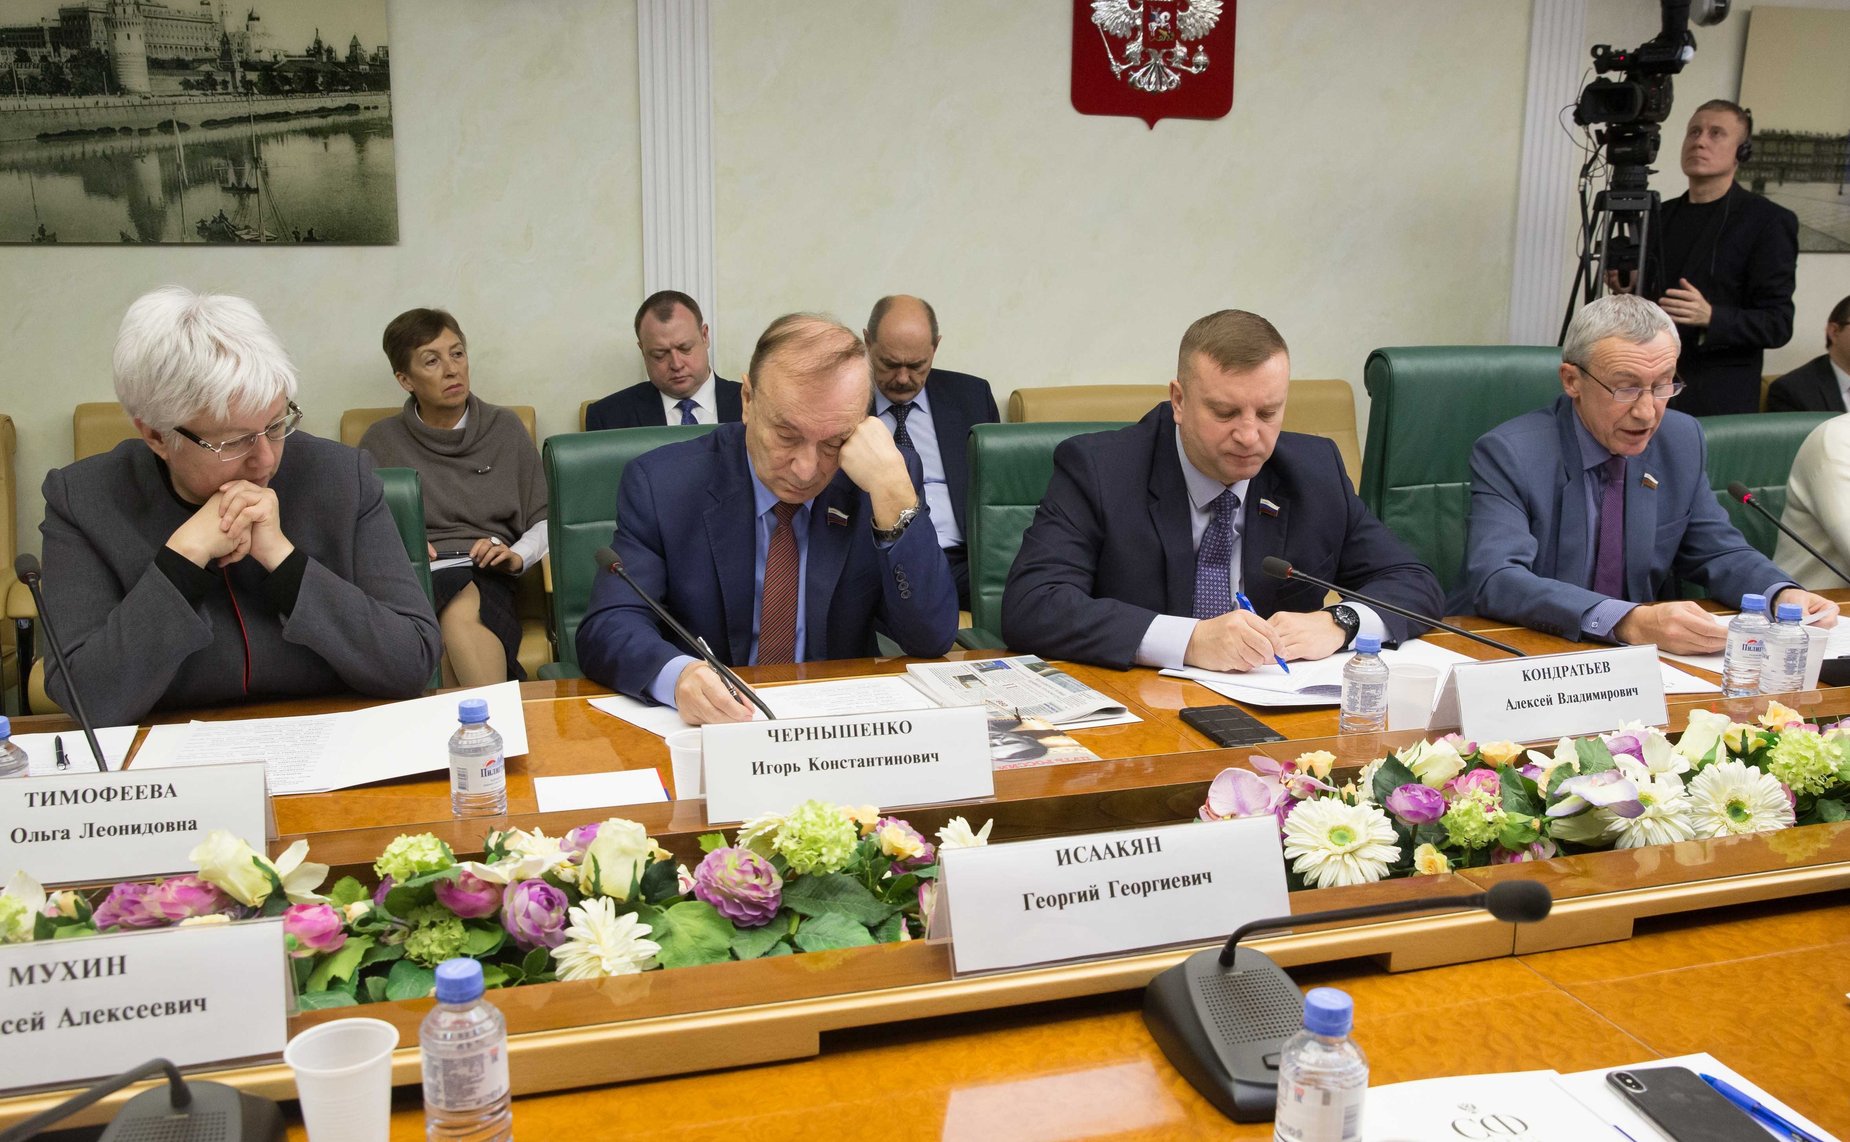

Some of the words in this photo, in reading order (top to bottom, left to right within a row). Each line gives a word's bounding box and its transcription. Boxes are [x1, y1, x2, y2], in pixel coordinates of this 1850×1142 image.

[1522, 660, 1611, 682] КОНДРАТЬЕВ
[1505, 692, 1553, 711] Алексей
[1558, 687, 1639, 705] Владимирович
[767, 720, 913, 743] ЧЕРНЫШЕНКО
[751, 760, 800, 777] Игорь
[808, 752, 940, 772] Константинович
[25, 782, 178, 808] ТИМОФЕЕВА
[10, 827, 71, 844] Ольга
[79, 819, 198, 839] Леонидовна
[1056, 835, 1162, 866] ИСААКЯН
[1022, 884, 1100, 911] Георгий
[1107, 871, 1213, 899] Георгиевич
[8, 954, 127, 988] МУХИН
[0, 1010, 46, 1036] сей
[57, 997, 208, 1029] Алексеевич
[1451, 1114, 1529, 1140] СФ
